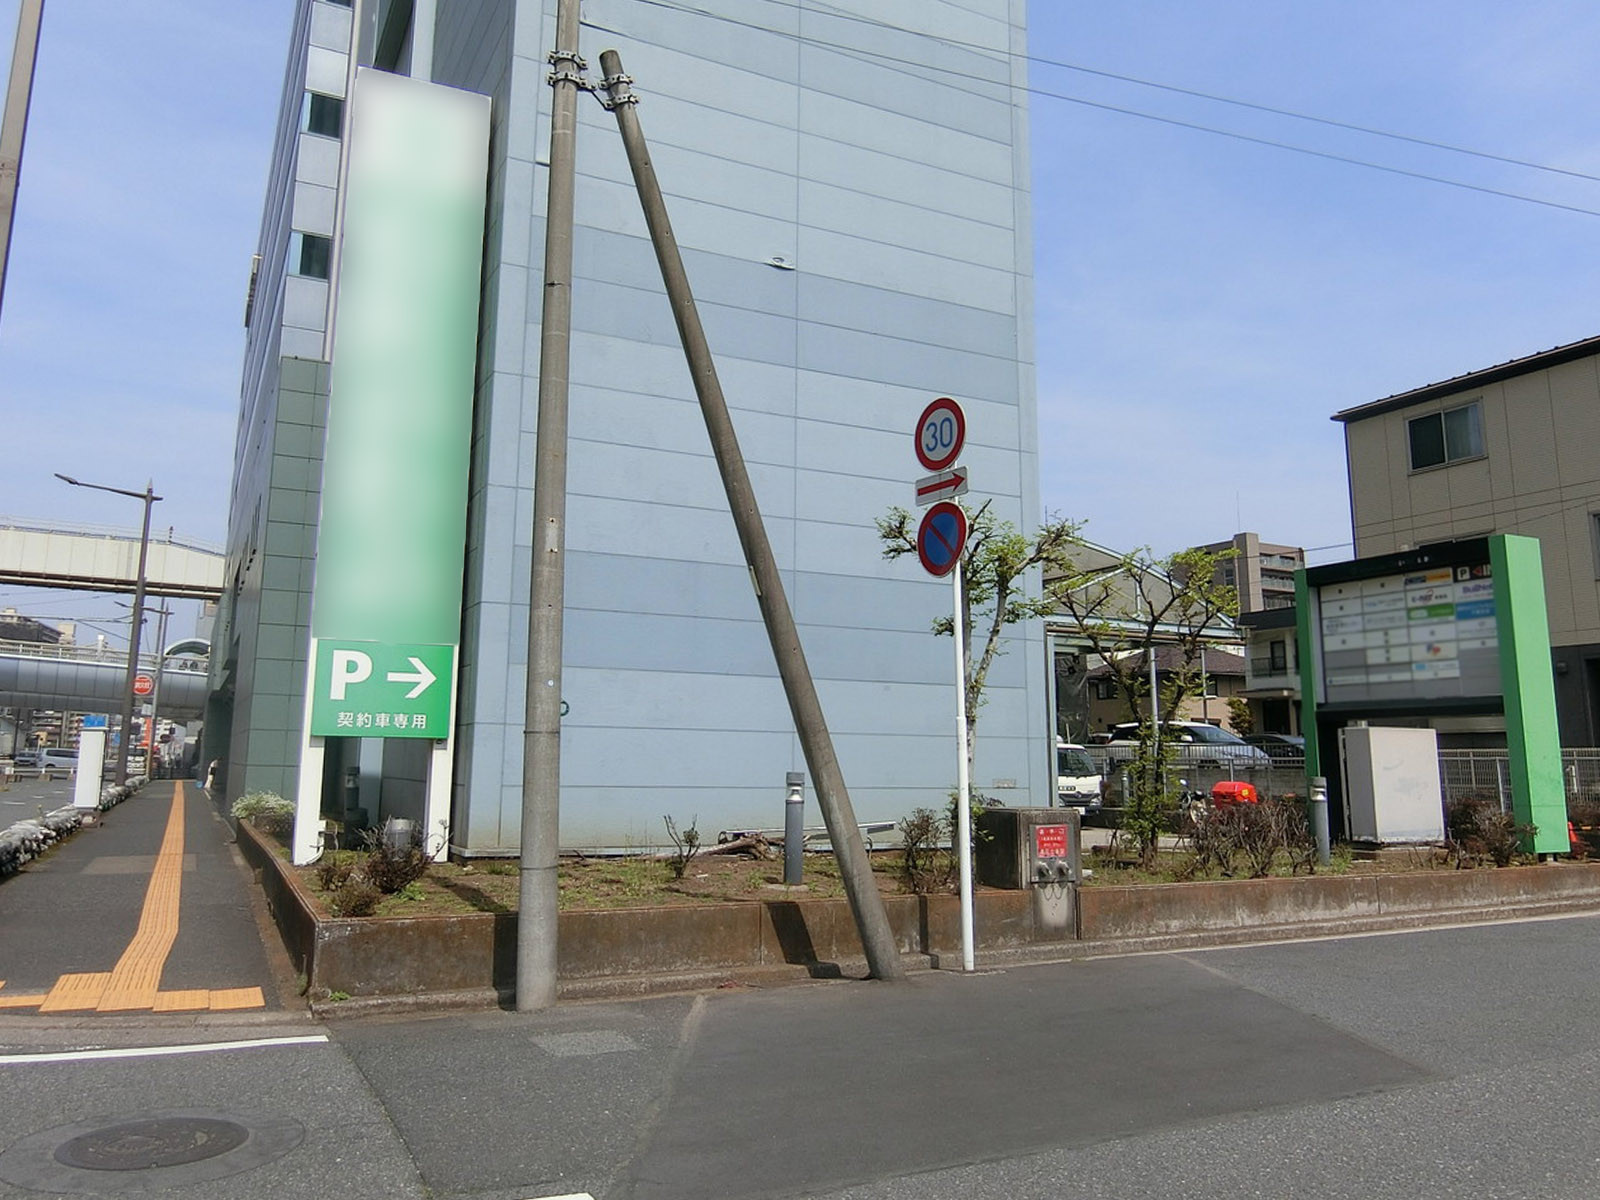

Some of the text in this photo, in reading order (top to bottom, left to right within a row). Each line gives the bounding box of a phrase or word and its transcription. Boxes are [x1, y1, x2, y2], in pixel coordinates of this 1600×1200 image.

[925, 417, 953, 452] 30
[330, 649, 373, 701] P
[337, 711, 427, 729] 契約車専用
